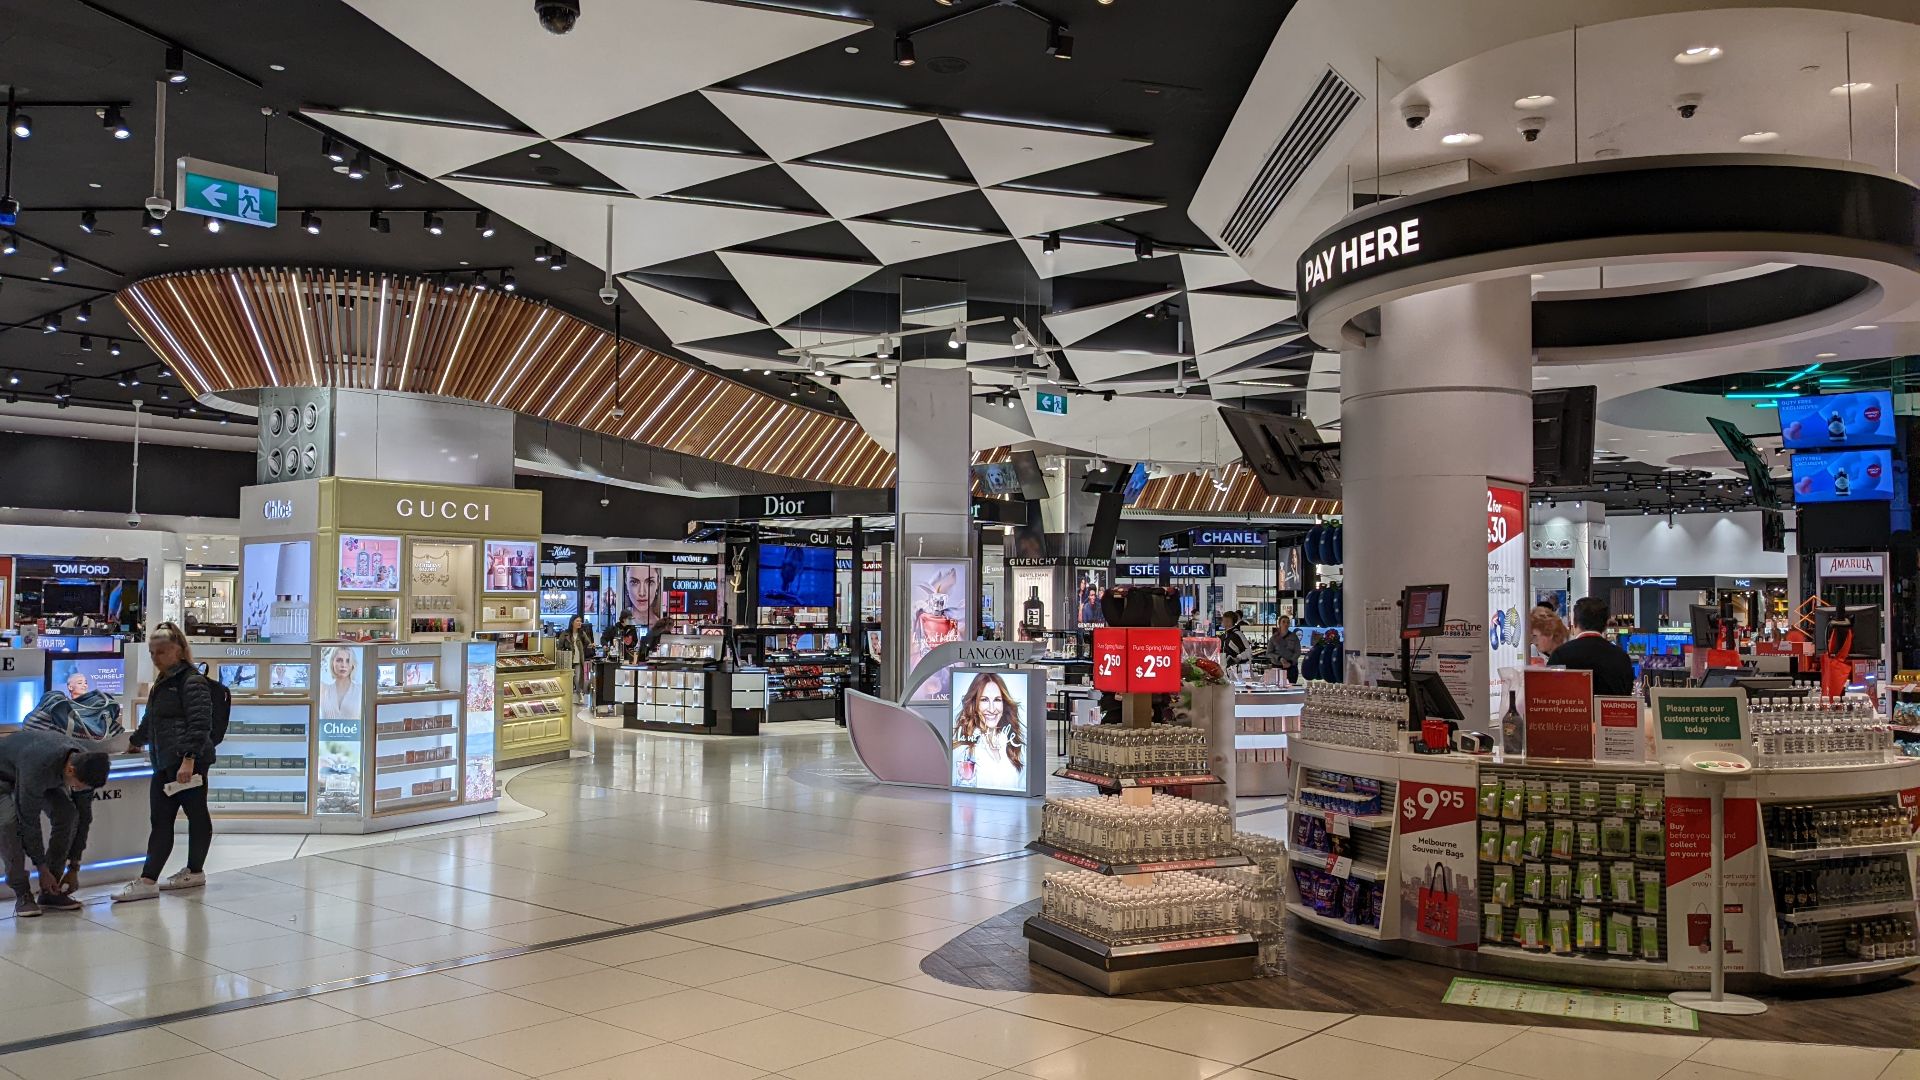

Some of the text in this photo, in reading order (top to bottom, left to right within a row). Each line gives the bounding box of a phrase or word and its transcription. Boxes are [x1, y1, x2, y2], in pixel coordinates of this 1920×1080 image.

[1305, 218, 1420, 293] PAY HERE
[263, 499, 292, 519] Chloé
[396, 499, 489, 521] GUCCI
[763, 495, 805, 516] Dior
[1492, 499, 1503, 513] for
[1202, 532, 1262, 544] CHANEL
[672, 554, 702, 563] LANCÔME
[1009, 557, 1058, 566] GIVENCHY
[1073, 557, 1111, 567] GIVENCHY
[52, 564, 110, 574] TOM FORD
[1830, 557, 1874, 573] AMARULA
[672, 581, 702, 590] GIORGIO
[958, 646, 1025, 661] LANCÔME
[1145, 644, 1162, 653] Spring
[1532, 697, 1547, 705] This
[1548, 698, 1574, 708] register
[1601, 702, 1636, 710] WARNING
[1529, 706, 1563, 714] currently
[1666, 704, 1691, 713] Please
[1691, 705, 1708, 713] rate
[1663, 715, 1731, 723] customer service
[323, 722, 358, 735] Chloé
[1684, 725, 1708, 735] today
[92, 789, 122, 801] AKE
[1669, 822, 1685, 831] Buy
[1669, 831, 1695, 839] before
[1696, 833, 1710, 841] you
[1418, 836, 1458, 849] Melbourne
[1412, 844, 1465, 860] Souvenir Bags
[1681, 851, 1700, 859] your
[1691, 881, 1709, 889] enjoy
